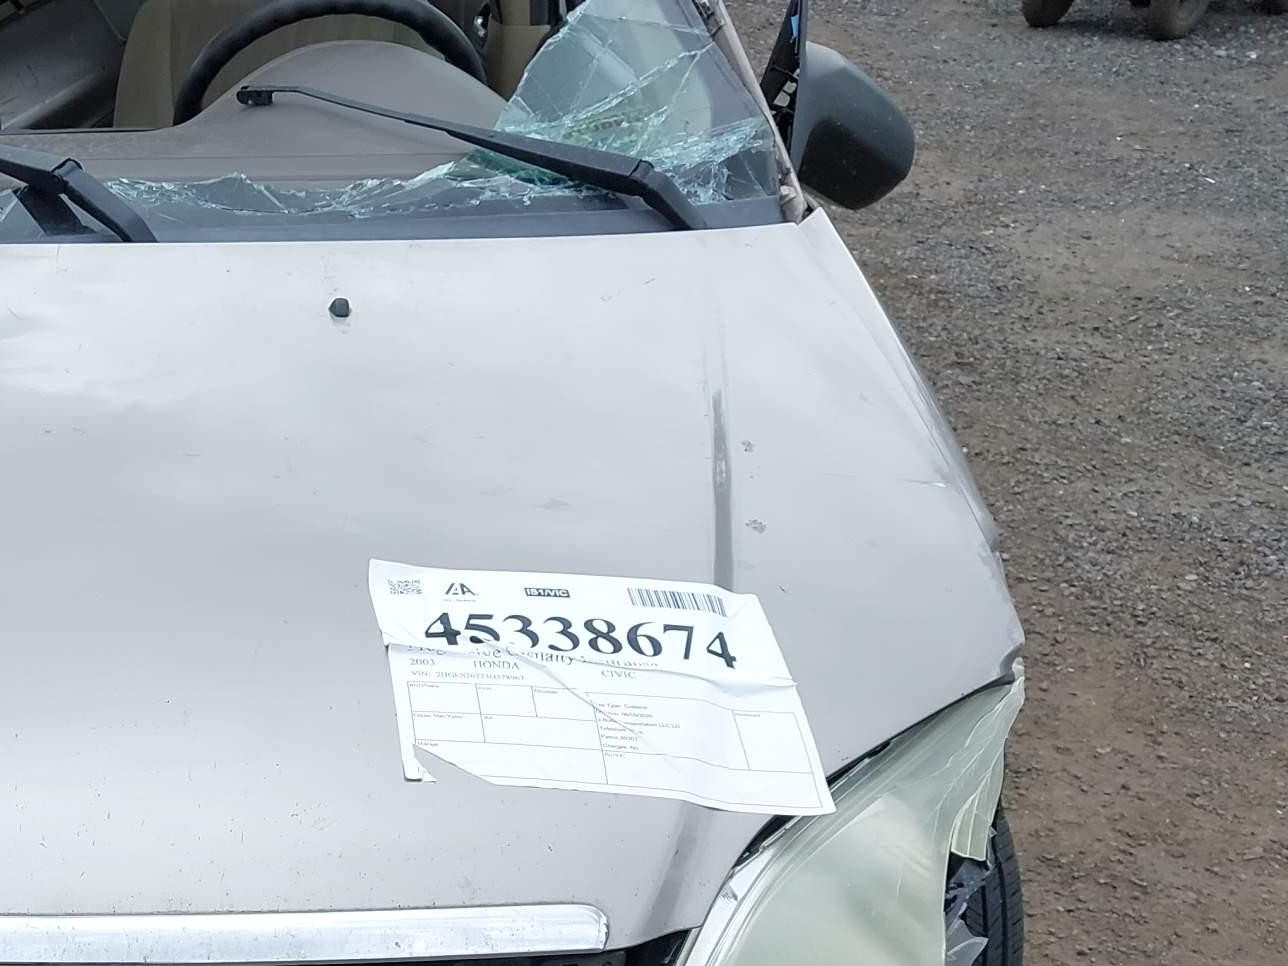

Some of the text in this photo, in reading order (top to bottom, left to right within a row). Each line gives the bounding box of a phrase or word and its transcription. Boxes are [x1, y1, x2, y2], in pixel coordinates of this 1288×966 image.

[424, 612, 737, 669] 45338674
[409, 658, 637, 679] 2003 HONDA CIVIC
